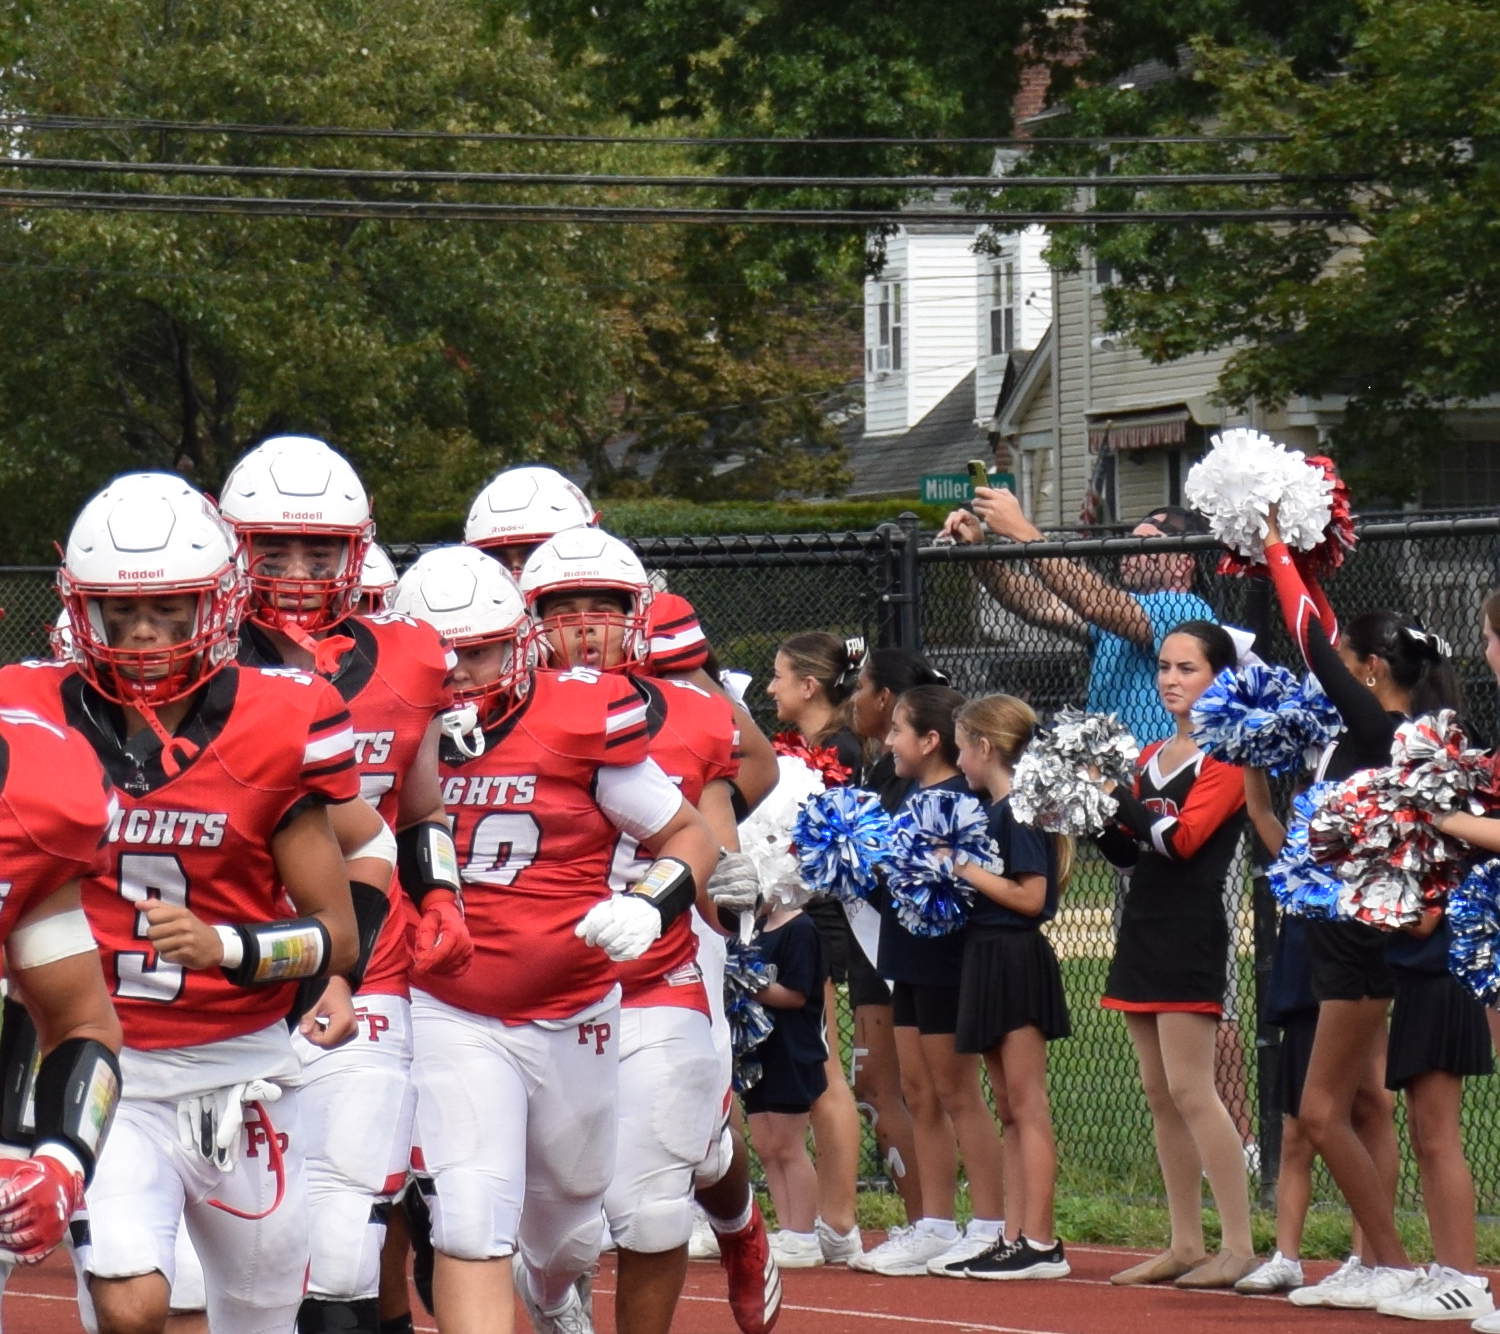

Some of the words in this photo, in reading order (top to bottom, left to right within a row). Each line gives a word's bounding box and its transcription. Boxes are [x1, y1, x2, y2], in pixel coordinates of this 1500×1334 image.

[926, 479, 970, 500] Miller
[282, 510, 323, 521] Riddell
[117, 569, 164, 581] Riddell
[443, 775, 537, 805] GHTS
[108, 809, 228, 847] IGHTS
[245, 1121, 289, 1172] FP
